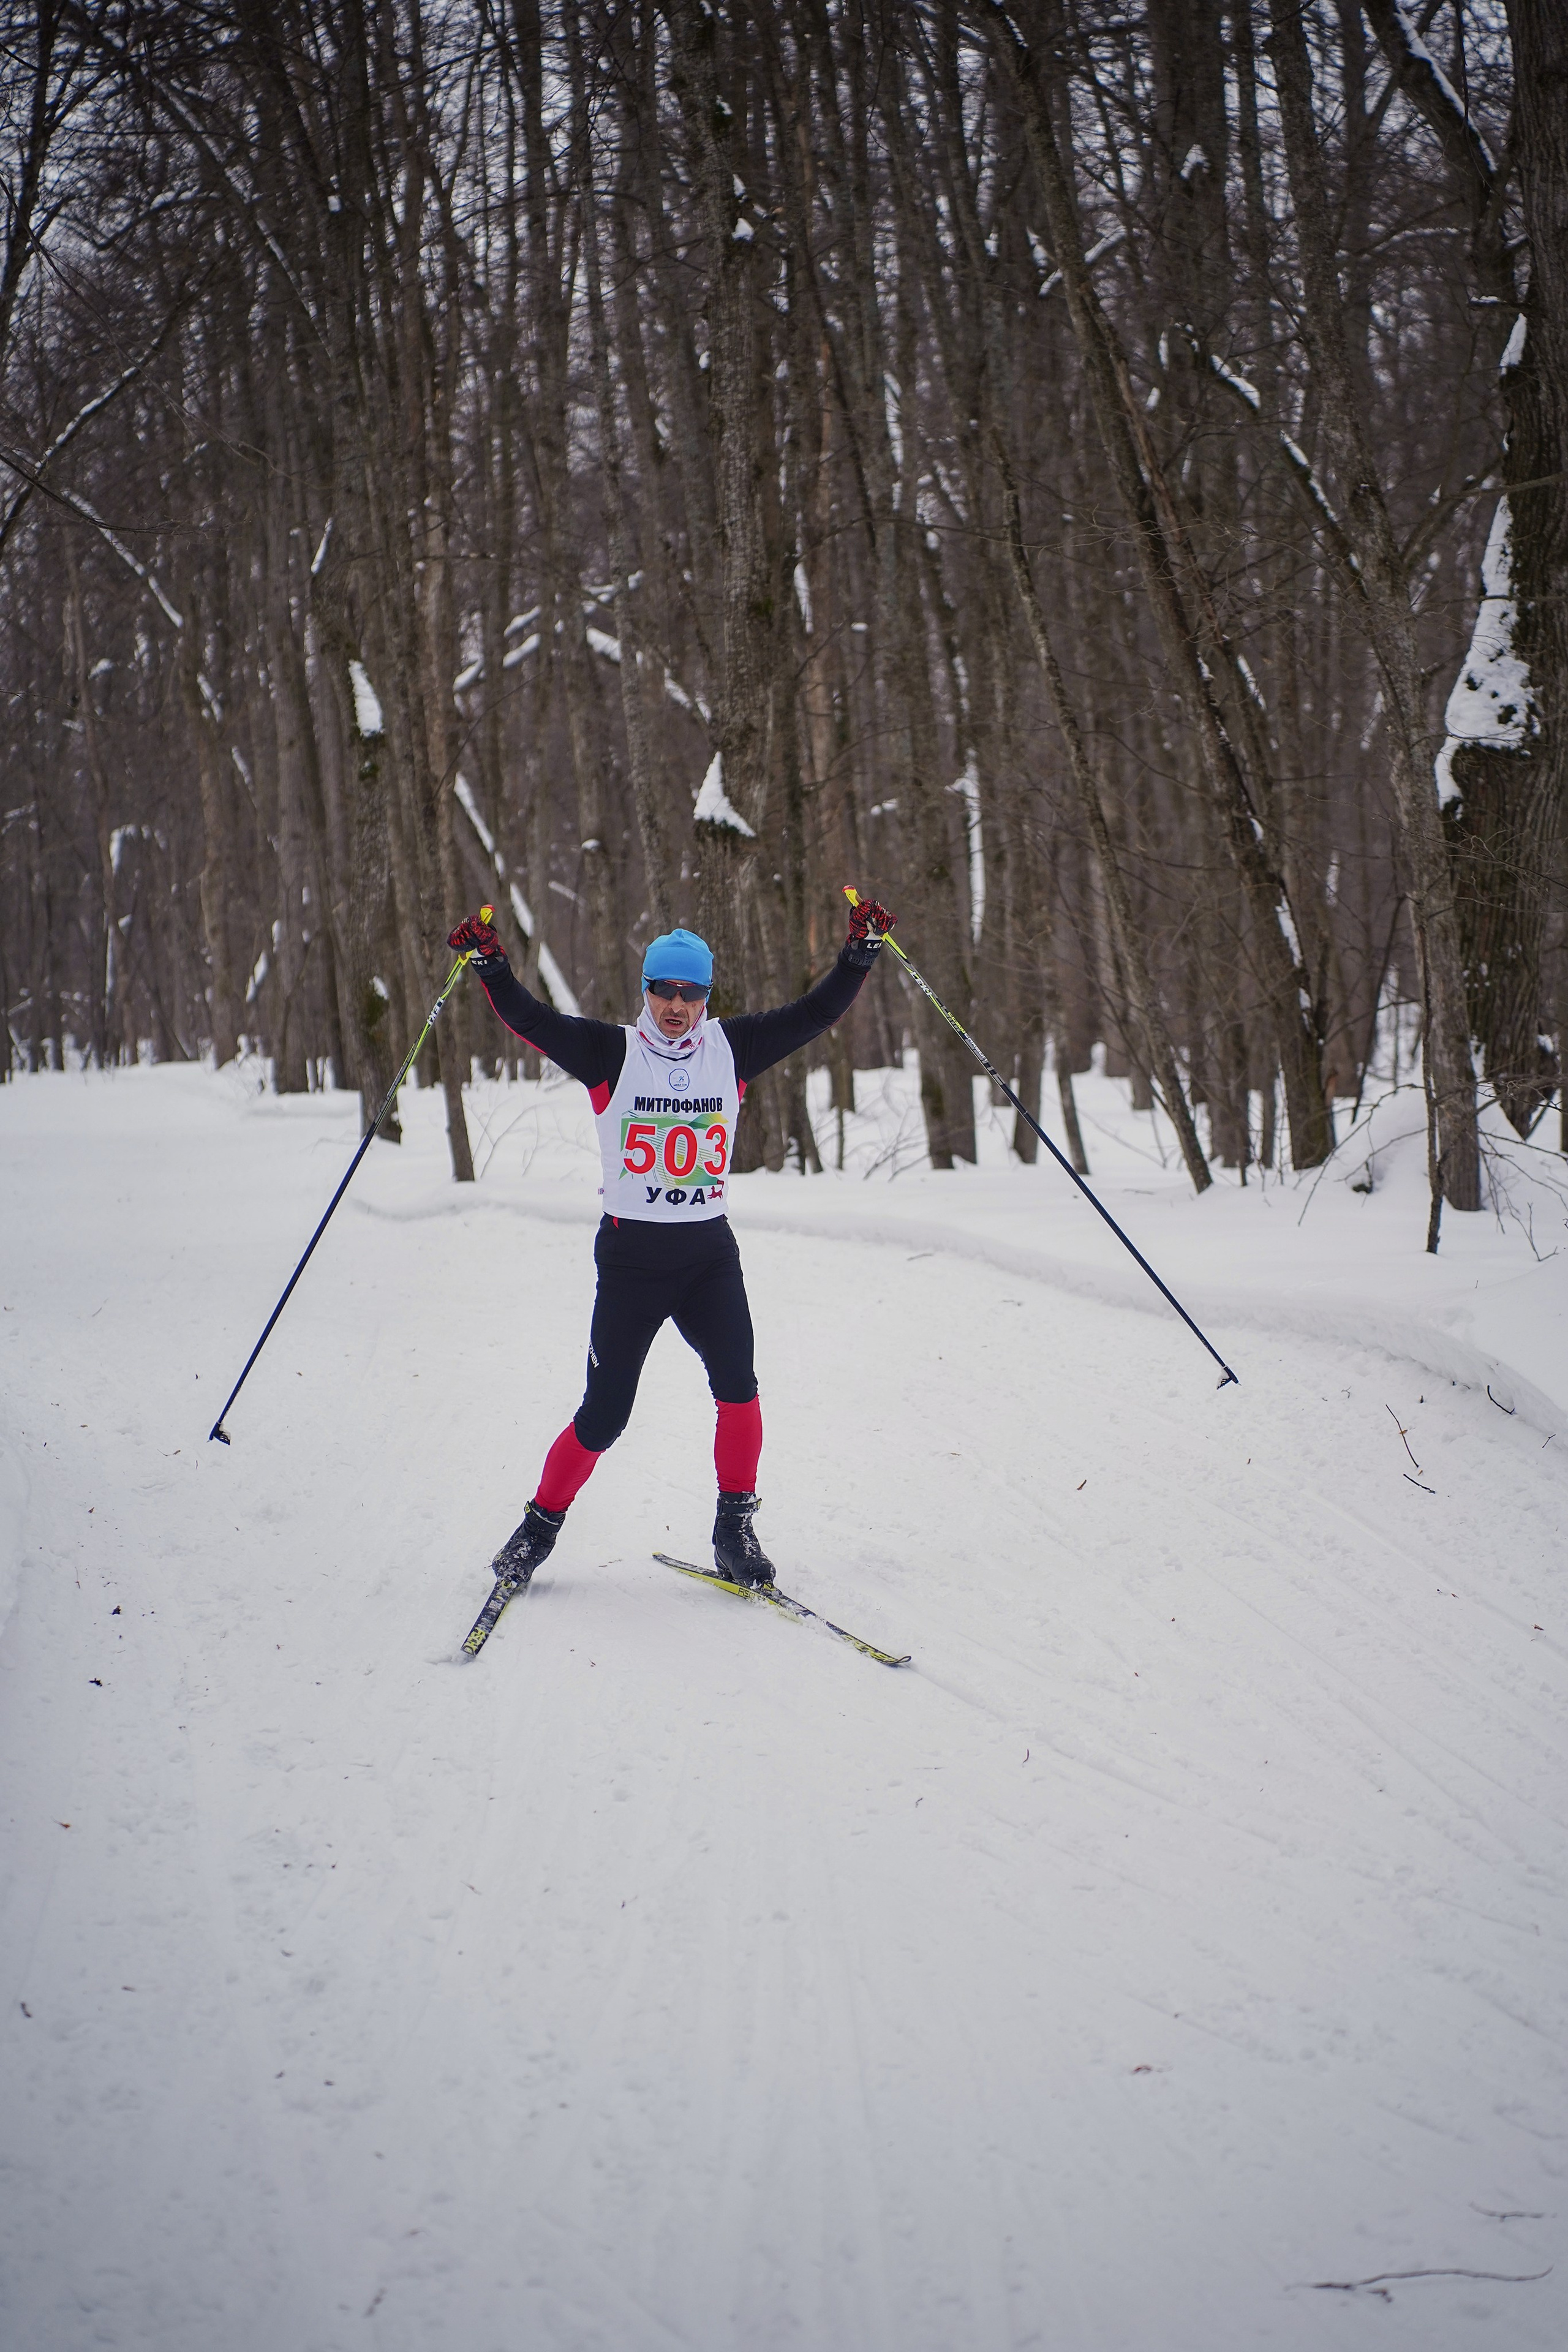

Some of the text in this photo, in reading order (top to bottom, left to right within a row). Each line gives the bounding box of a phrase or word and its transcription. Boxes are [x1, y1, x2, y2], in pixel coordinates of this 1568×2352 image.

[910, 971, 932, 997] LEKI
[427, 997, 444, 1025] LEKI
[634, 1096, 723, 1113] МИТРОФАНОВ
[624, 1123, 726, 1177] 503
[646, 1186, 706, 1205] УФА
[589, 1340, 600, 1368] ZHEN
